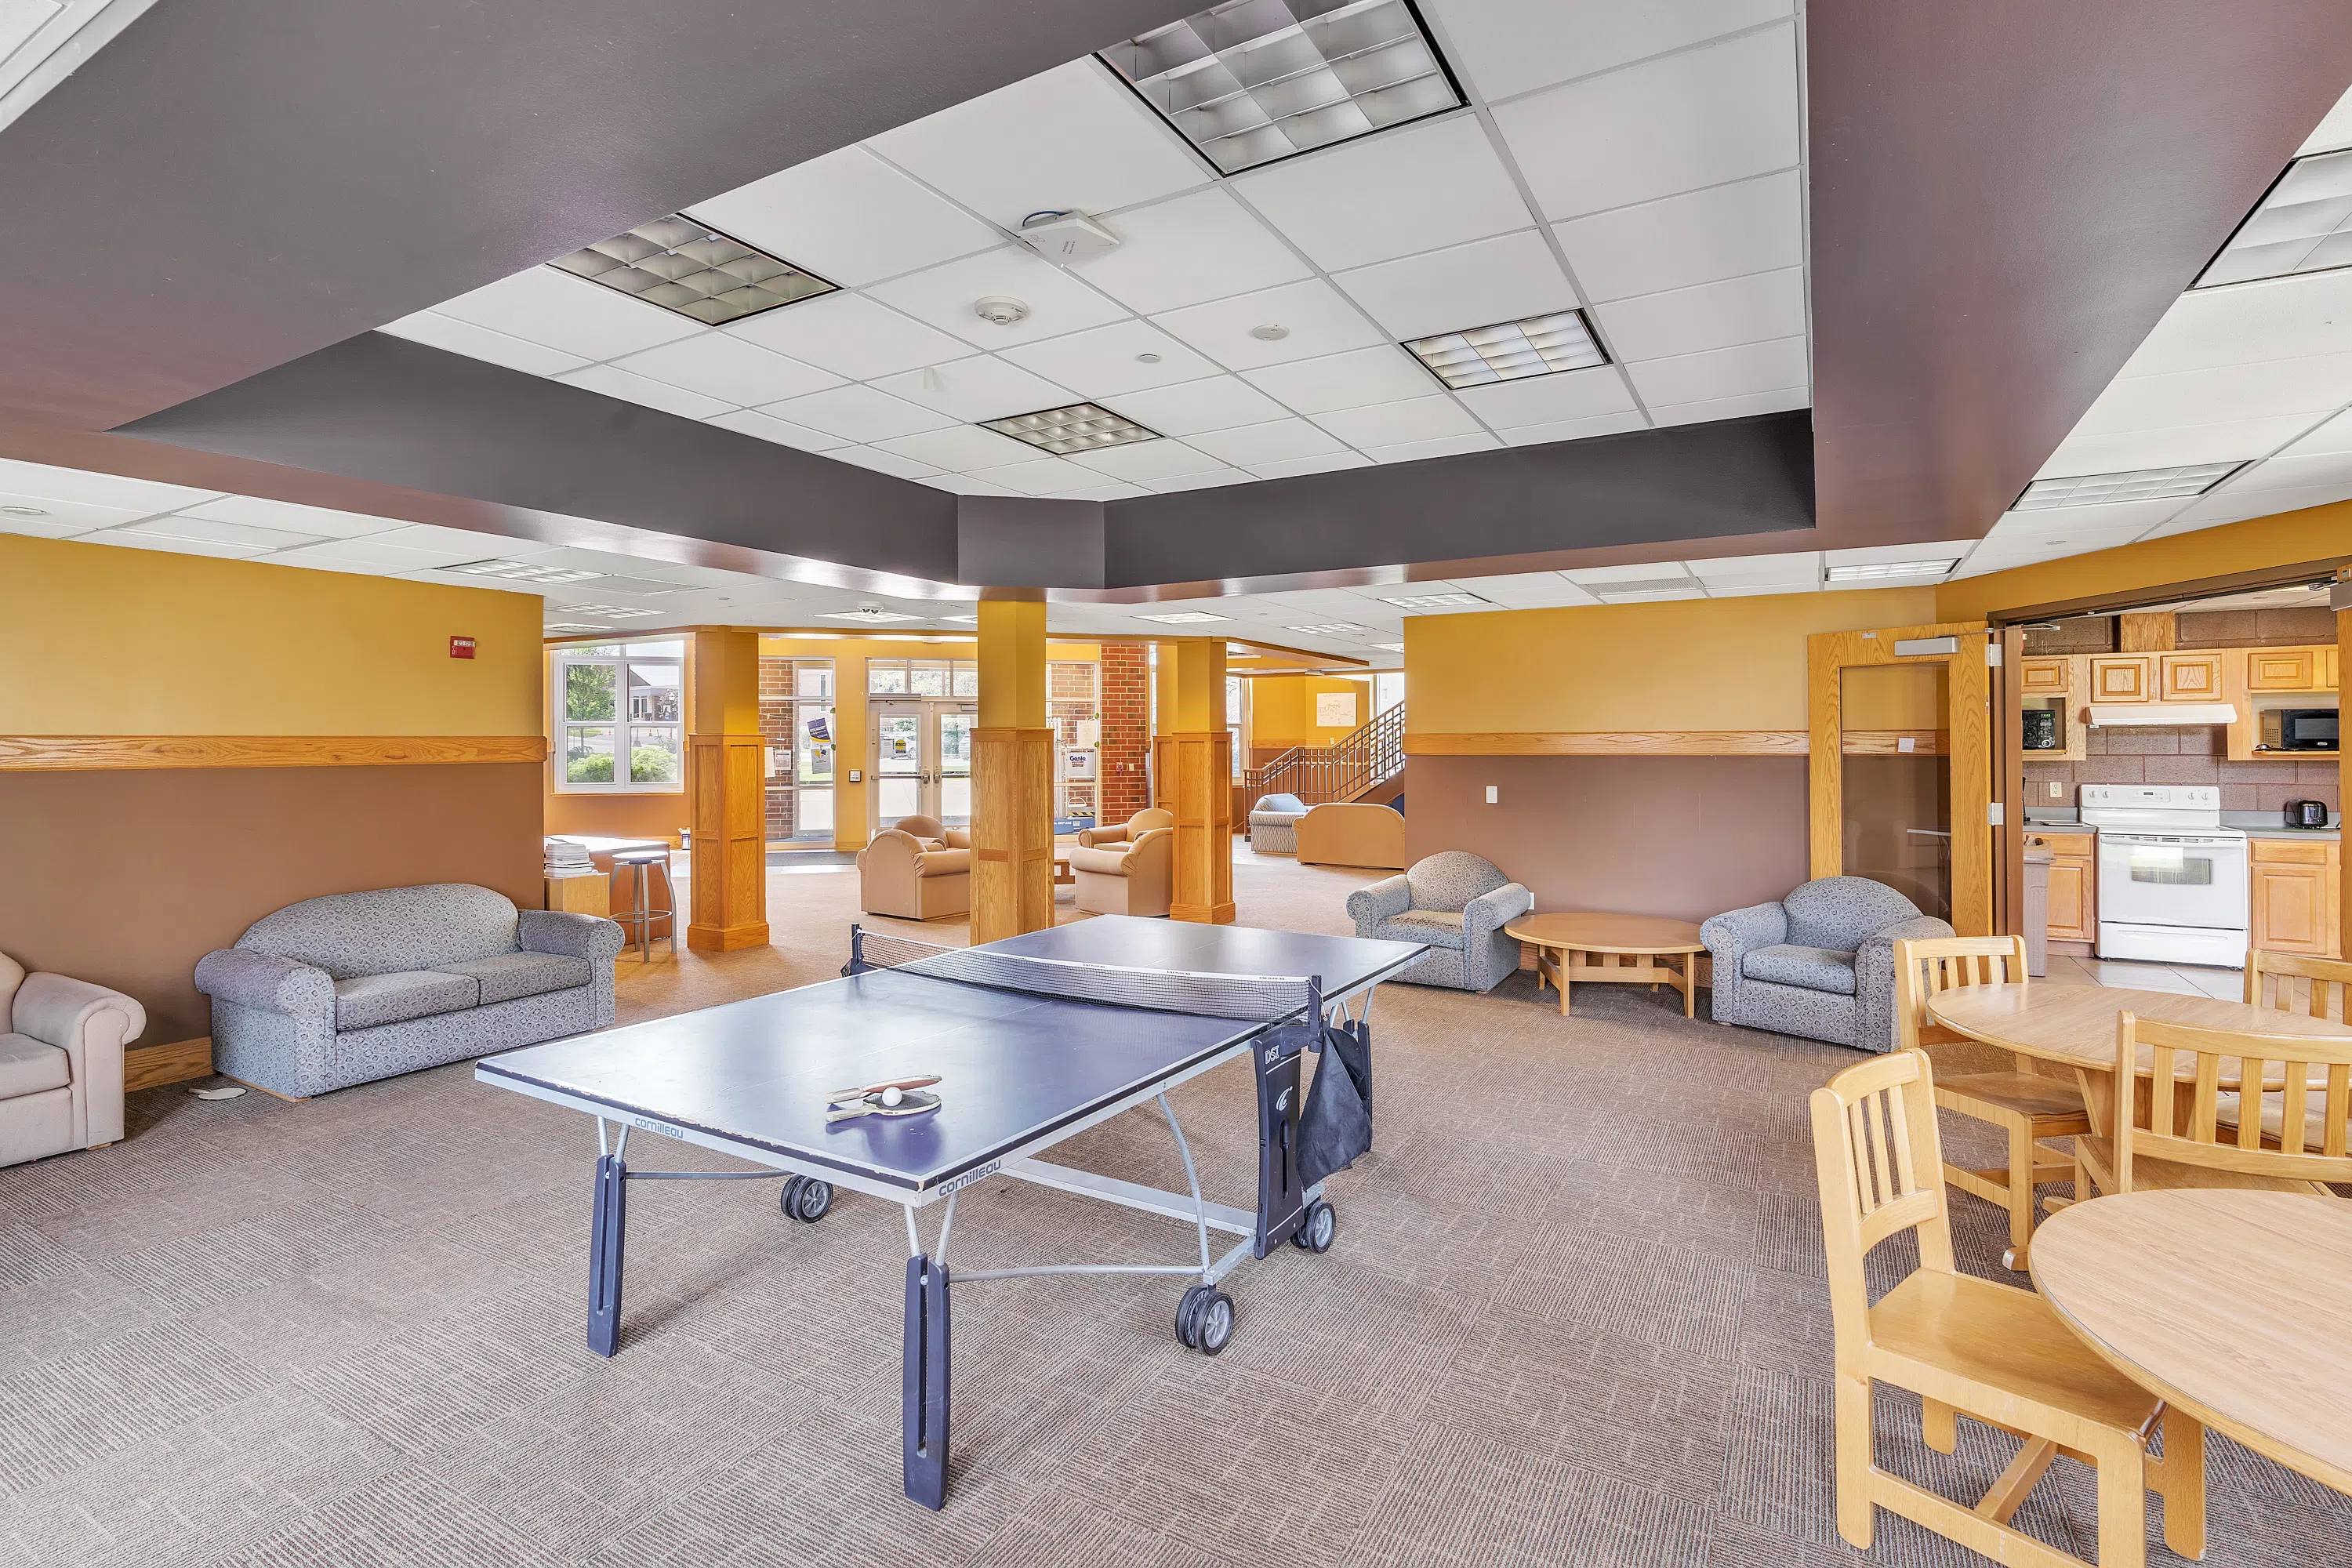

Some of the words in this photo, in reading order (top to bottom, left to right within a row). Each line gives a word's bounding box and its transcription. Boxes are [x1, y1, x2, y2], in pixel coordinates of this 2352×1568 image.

[1265, 1045, 1279, 1065] DSI
[635, 1118, 684, 1138] cornilleau
[939, 1160, 1001, 1196] cornilleau
